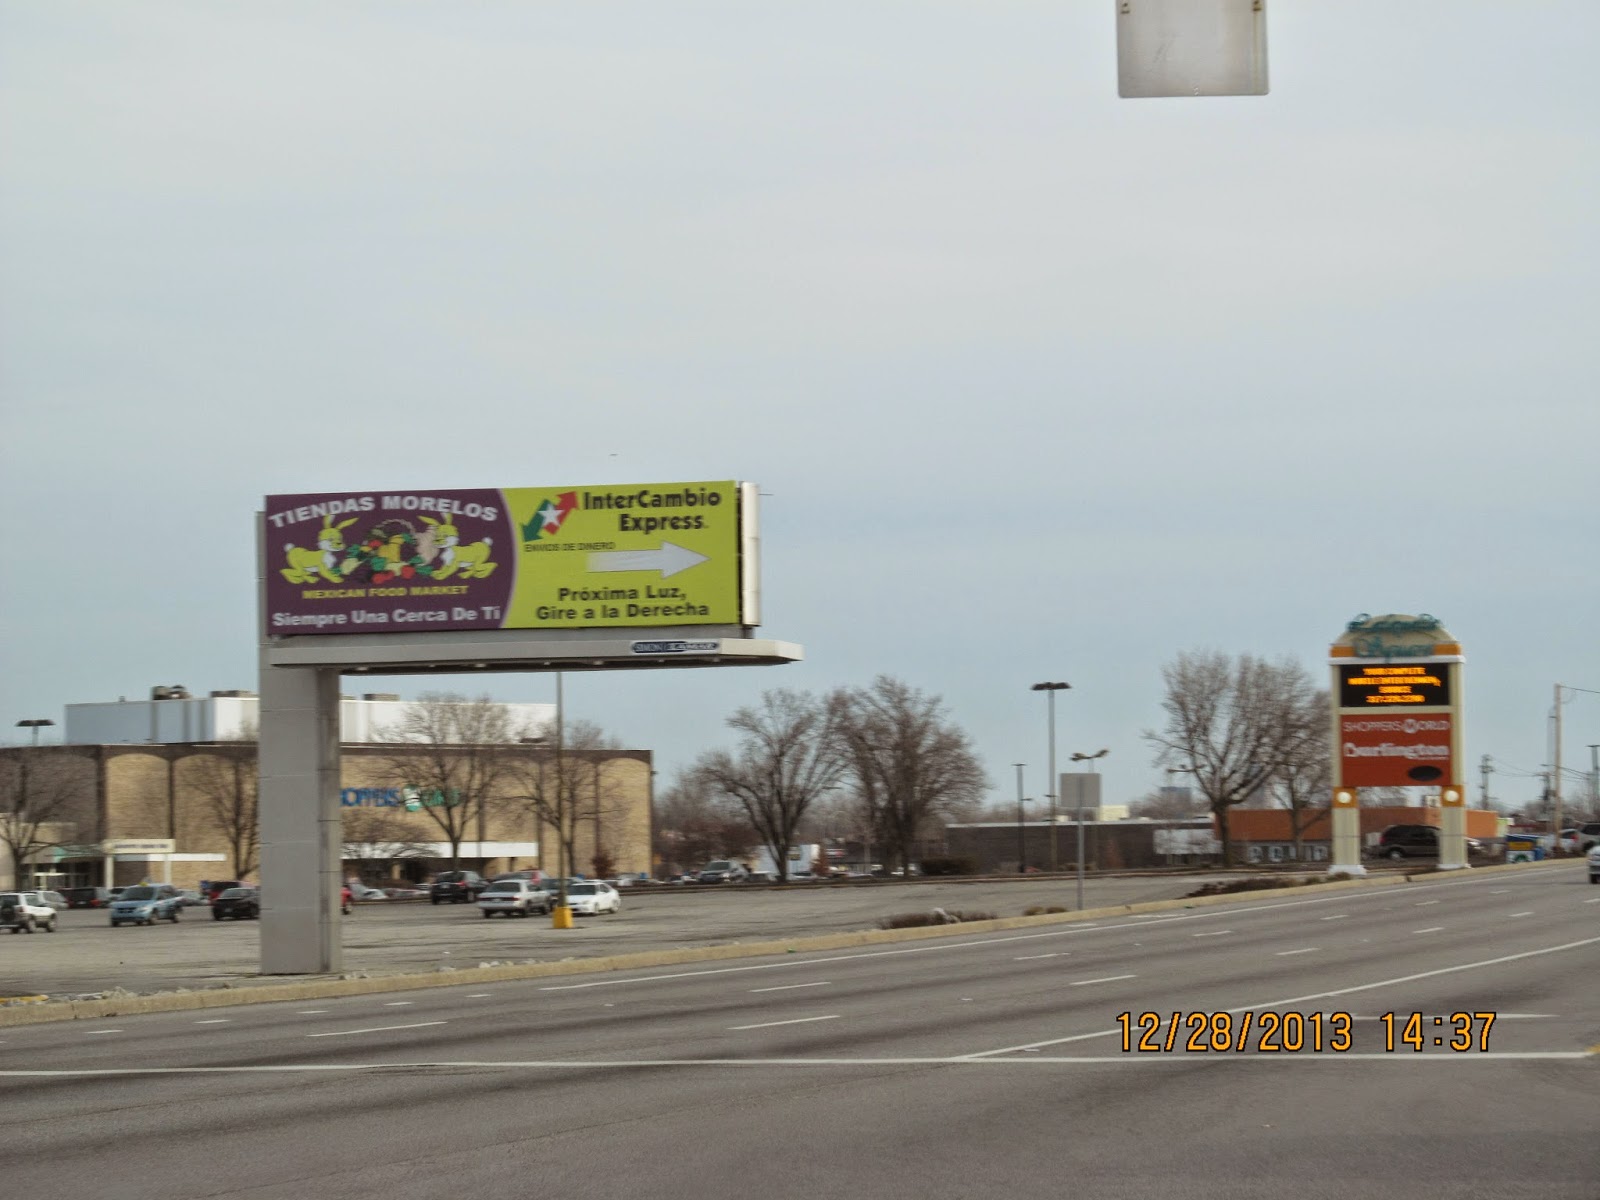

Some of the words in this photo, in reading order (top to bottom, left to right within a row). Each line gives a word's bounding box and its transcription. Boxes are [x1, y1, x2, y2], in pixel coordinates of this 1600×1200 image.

[583, 488, 722, 511] InterCambio
[268, 496, 375, 529] TIENDAS
[381, 495, 499, 522] MORELOS
[578, 541, 616, 551] DINERO
[302, 587, 366, 600] MEXICAN
[370, 586, 408, 598] FOOD
[410, 585, 470, 597] MARKET
[557, 587, 639, 602] Próxima
[272, 610, 348, 628] Siempre
[351, 609, 388, 624] Una
[391, 608, 448, 623] Cerca
[452, 607, 478, 621] De
[481, 605, 501, 620] Ti
[536, 605, 579, 621] Gire
[583, 607, 595, 619] a
[602, 604, 620, 619] la
[626, 602, 710, 619] Derecha
